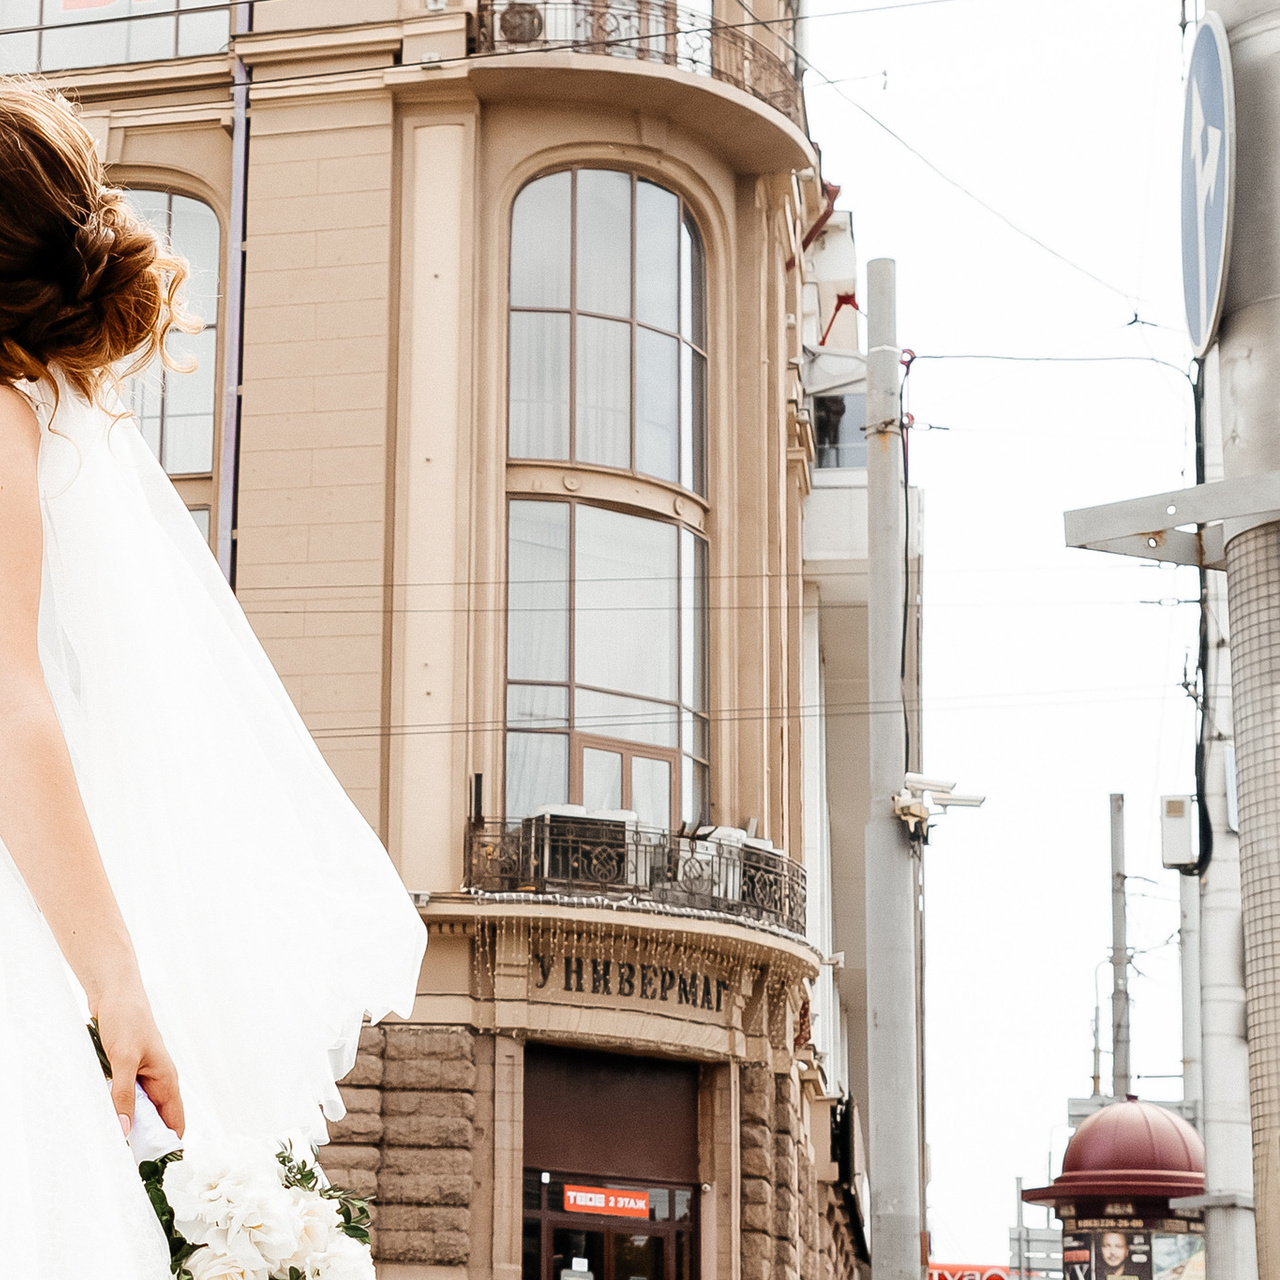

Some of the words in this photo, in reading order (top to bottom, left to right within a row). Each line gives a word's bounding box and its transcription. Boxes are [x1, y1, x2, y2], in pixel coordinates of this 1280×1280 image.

[534, 954, 729, 1012] УНИВЕРМАГ
[608, 1196, 616, 1208] 2
[617, 1197, 647, 1211] ЭТАЖ
